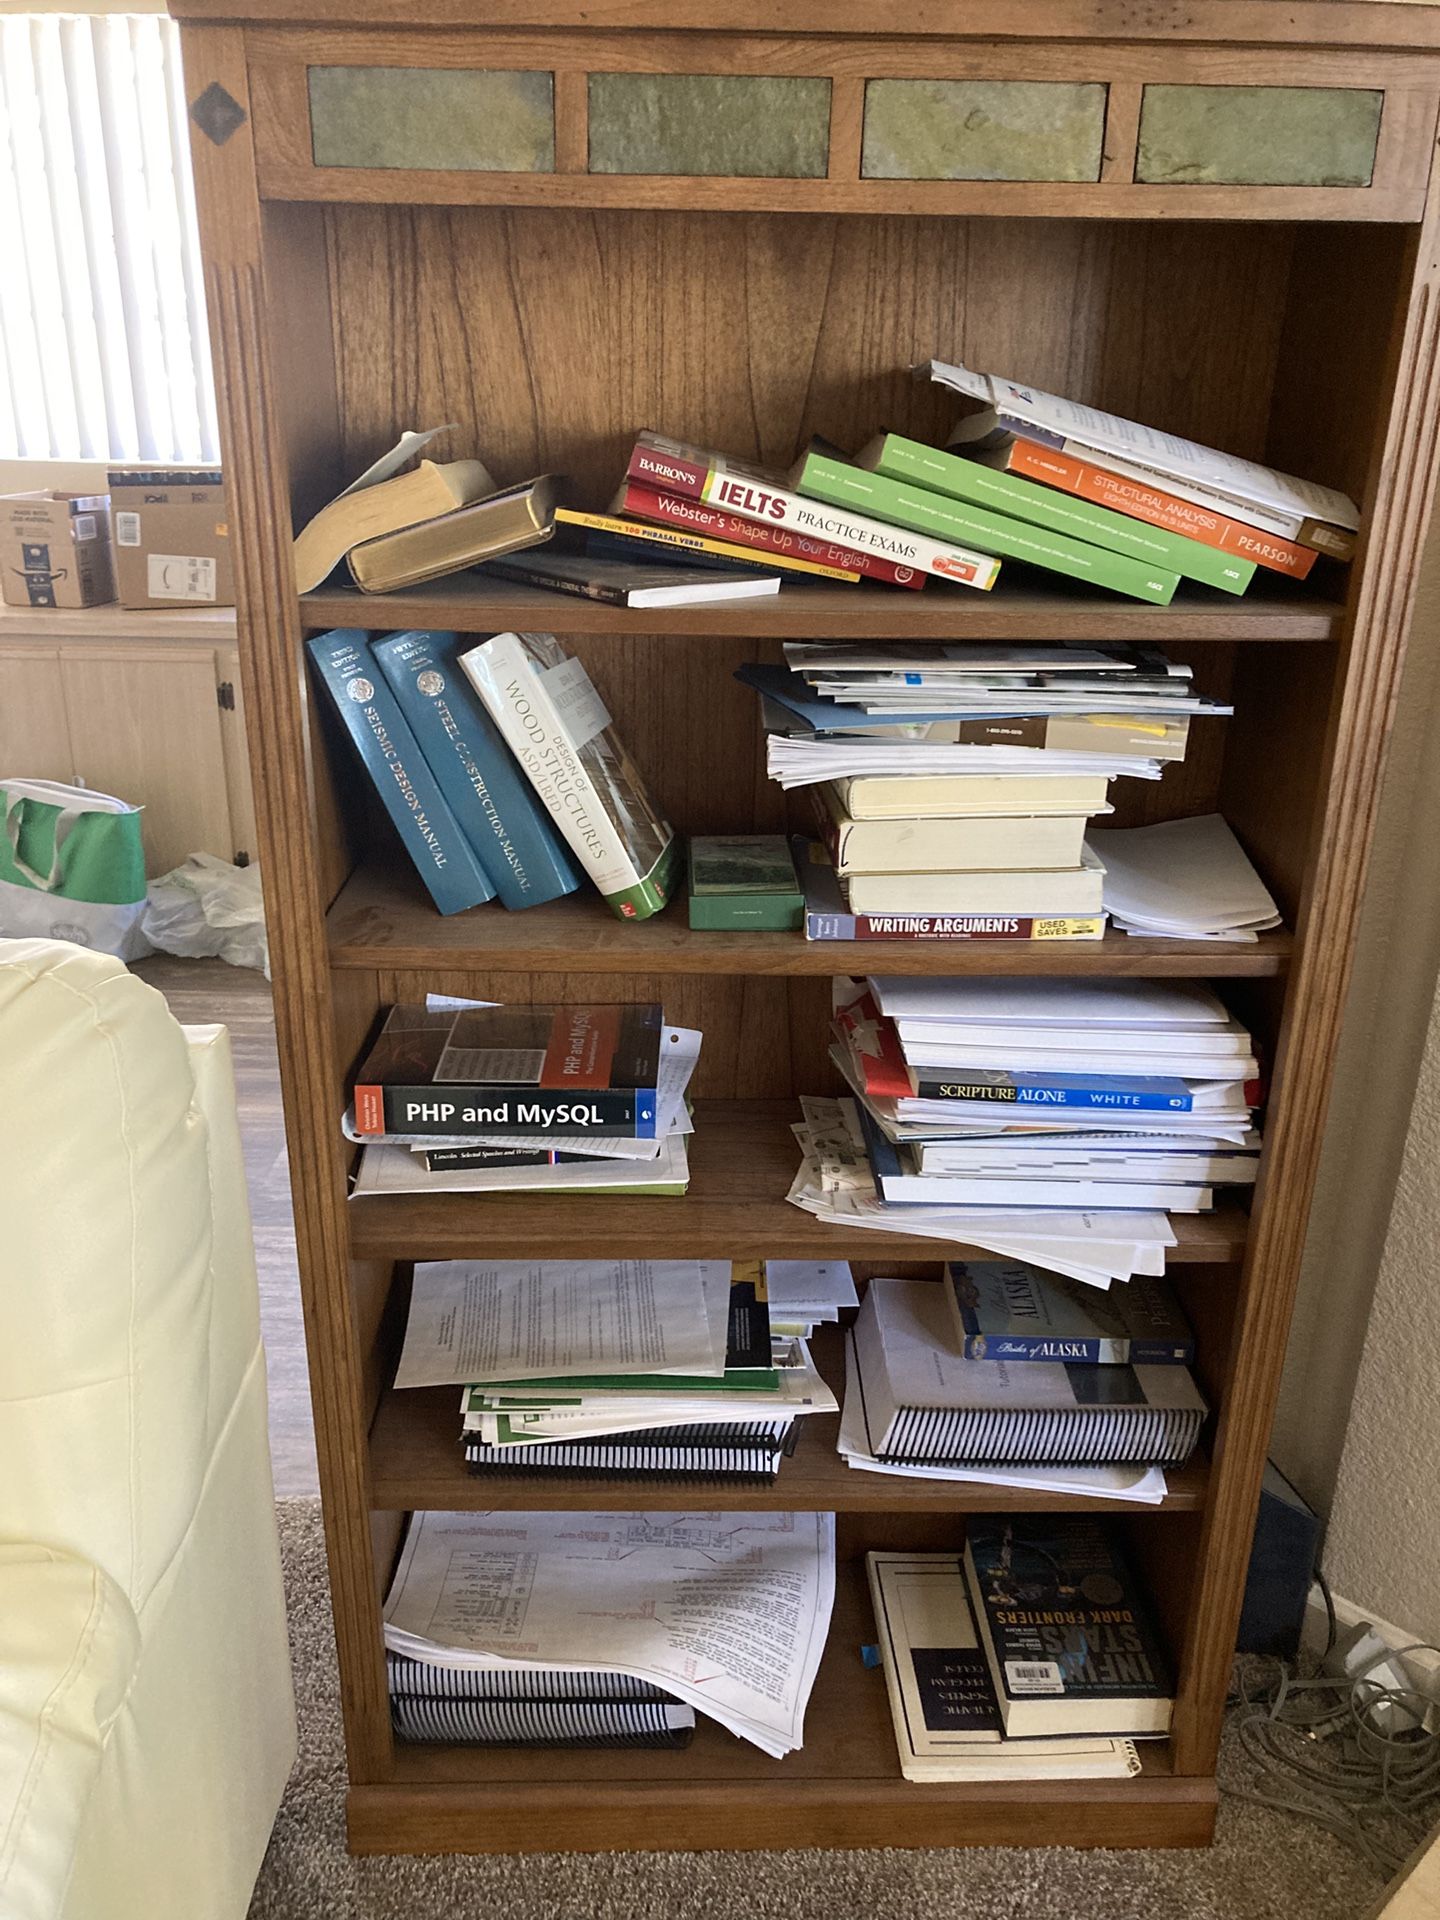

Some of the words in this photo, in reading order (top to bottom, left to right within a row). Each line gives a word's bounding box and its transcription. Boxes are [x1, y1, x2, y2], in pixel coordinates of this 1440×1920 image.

[639, 458, 696, 485] BARRON'S
[1093, 476, 1164, 510] STRUCTURAL
[1166, 503, 1217, 530] ANALYSIS
[1104, 492, 1130, 508] EIGHTH
[1131, 501, 1160, 518] EDITION
[657, 496, 725, 528] Webster's
[729, 516, 768, 547] Shape
[772, 528, 792, 550] Up
[797, 530, 827, 558] Your
[827, 543, 870, 570] English
[718, 480, 788, 520] IELTS
[797, 510, 867, 543] PRACTICE
[869, 533, 917, 559] EXAMS
[624, 526, 640, 534] 100
[642, 529, 678, 542] PHRASAL
[679, 537, 704, 548] VERBS
[1238, 536, 1297, 566] PEARSON
[506, 679, 546, 744] WOOD
[540, 747, 608, 860] STRUCTURES
[552, 736, 580, 778] DESIGN
[576, 776, 590, 792] OF
[364, 706, 398, 760] SEISMIC
[390, 757, 422, 810] DESIGN
[414, 812, 448, 870] MANUAL
[518, 746, 564, 814] ASD/LRFD
[434, 699, 461, 741] STEEL
[500, 834, 530, 894] MANUAL
[869, 918, 932, 932] WRITING
[933, 918, 1020, 933] ARGUMENTS
[1036, 928, 1068, 938] SAVES
[1038, 920, 1066, 930] USED
[567, 1038, 585, 1055] and
[562, 1056, 581, 1074] PHP
[939, 1085, 1016, 1100] SCRIPTURE
[1017, 1089, 1066, 1104] ALONE
[1090, 1094, 1141, 1106] WHITE
[406, 1103, 456, 1122] PHP
[462, 1104, 508, 1123] and
[516, 1104, 604, 1128] MySQL
[1002, 1269, 1039, 1320] ALASKA
[1029, 1343, 1042, 1358] of
[1040, 1342, 1088, 1357] ALASKA
[996, 1610, 1086, 1624] FRONTIERS
[1089, 1610, 1133, 1624] DARK
[1041, 1625, 1143, 1653] STARS
[1005, 1654, 1154, 1682] INFIN
